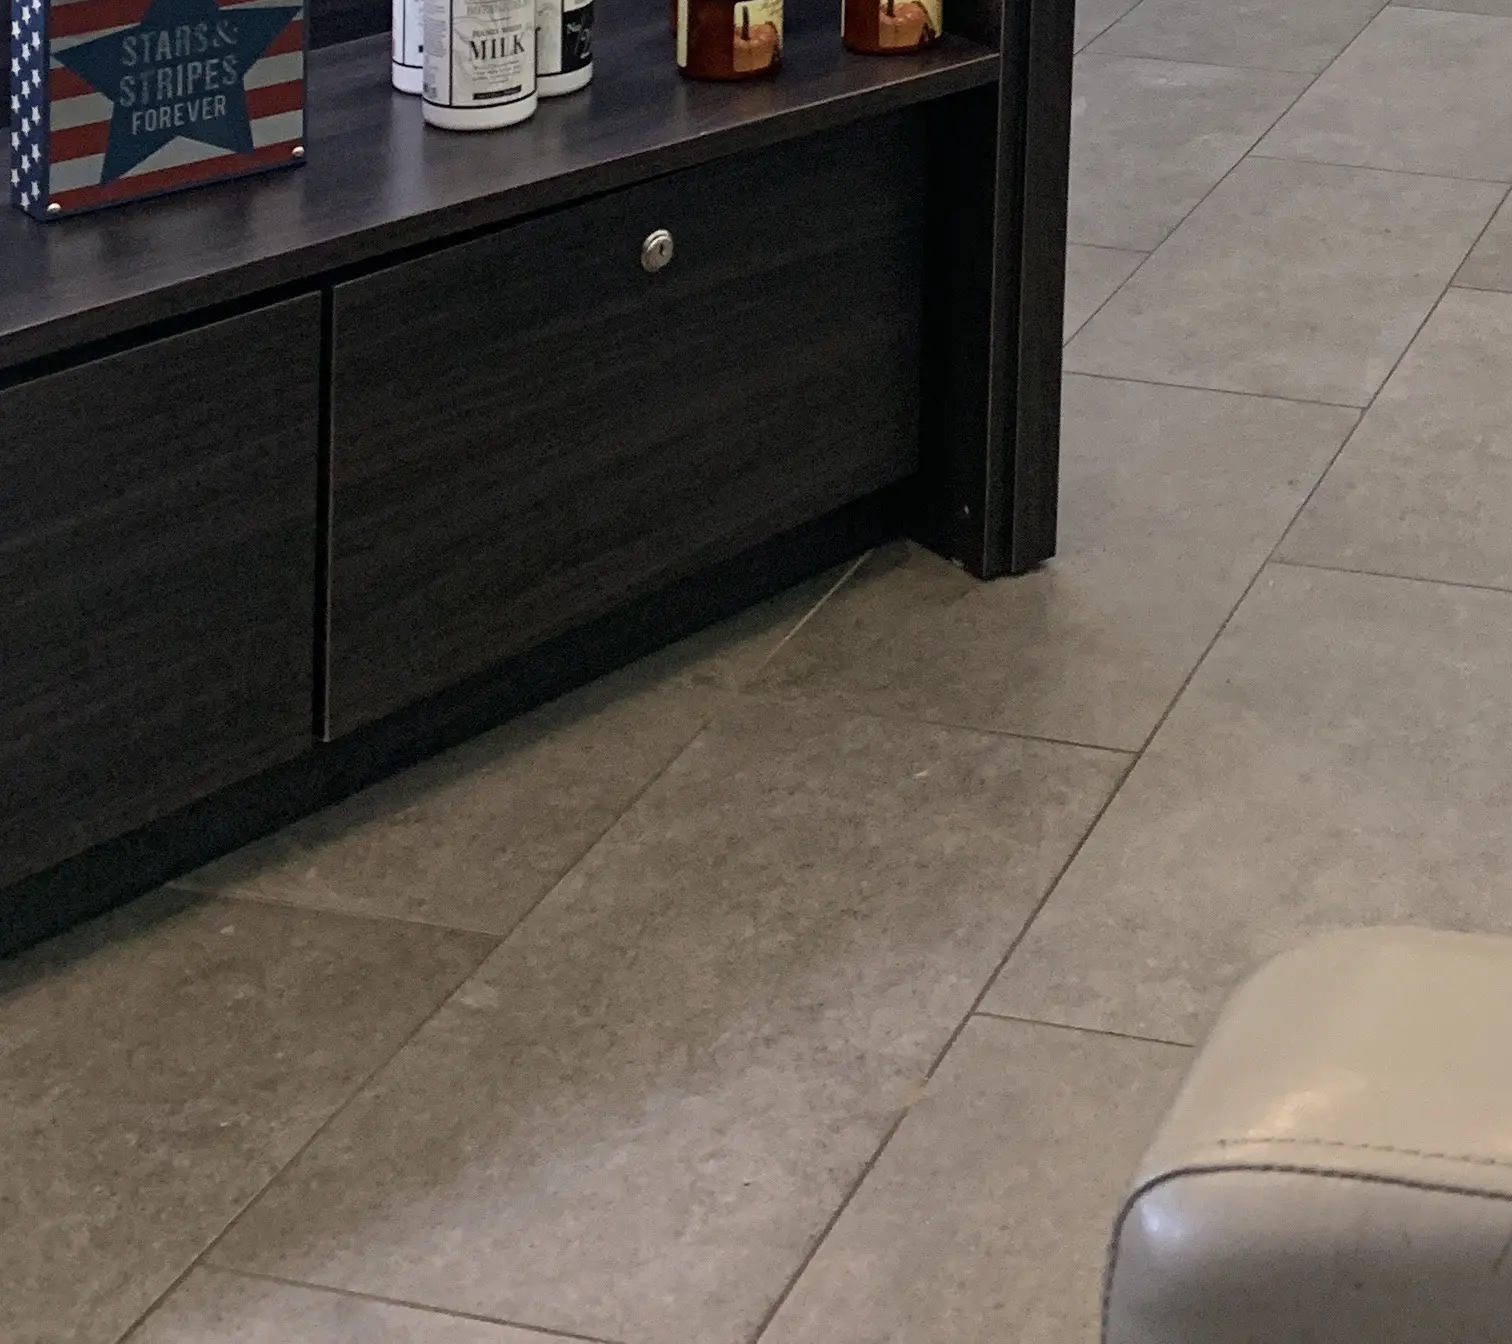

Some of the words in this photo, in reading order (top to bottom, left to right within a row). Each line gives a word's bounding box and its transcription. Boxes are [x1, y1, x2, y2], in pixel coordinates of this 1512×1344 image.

[121, 23, 209, 67] STARS
[468, 33, 525, 62] MILK
[120, 54, 240, 108] STRIPES
[131, 94, 227, 136] FOREVER
